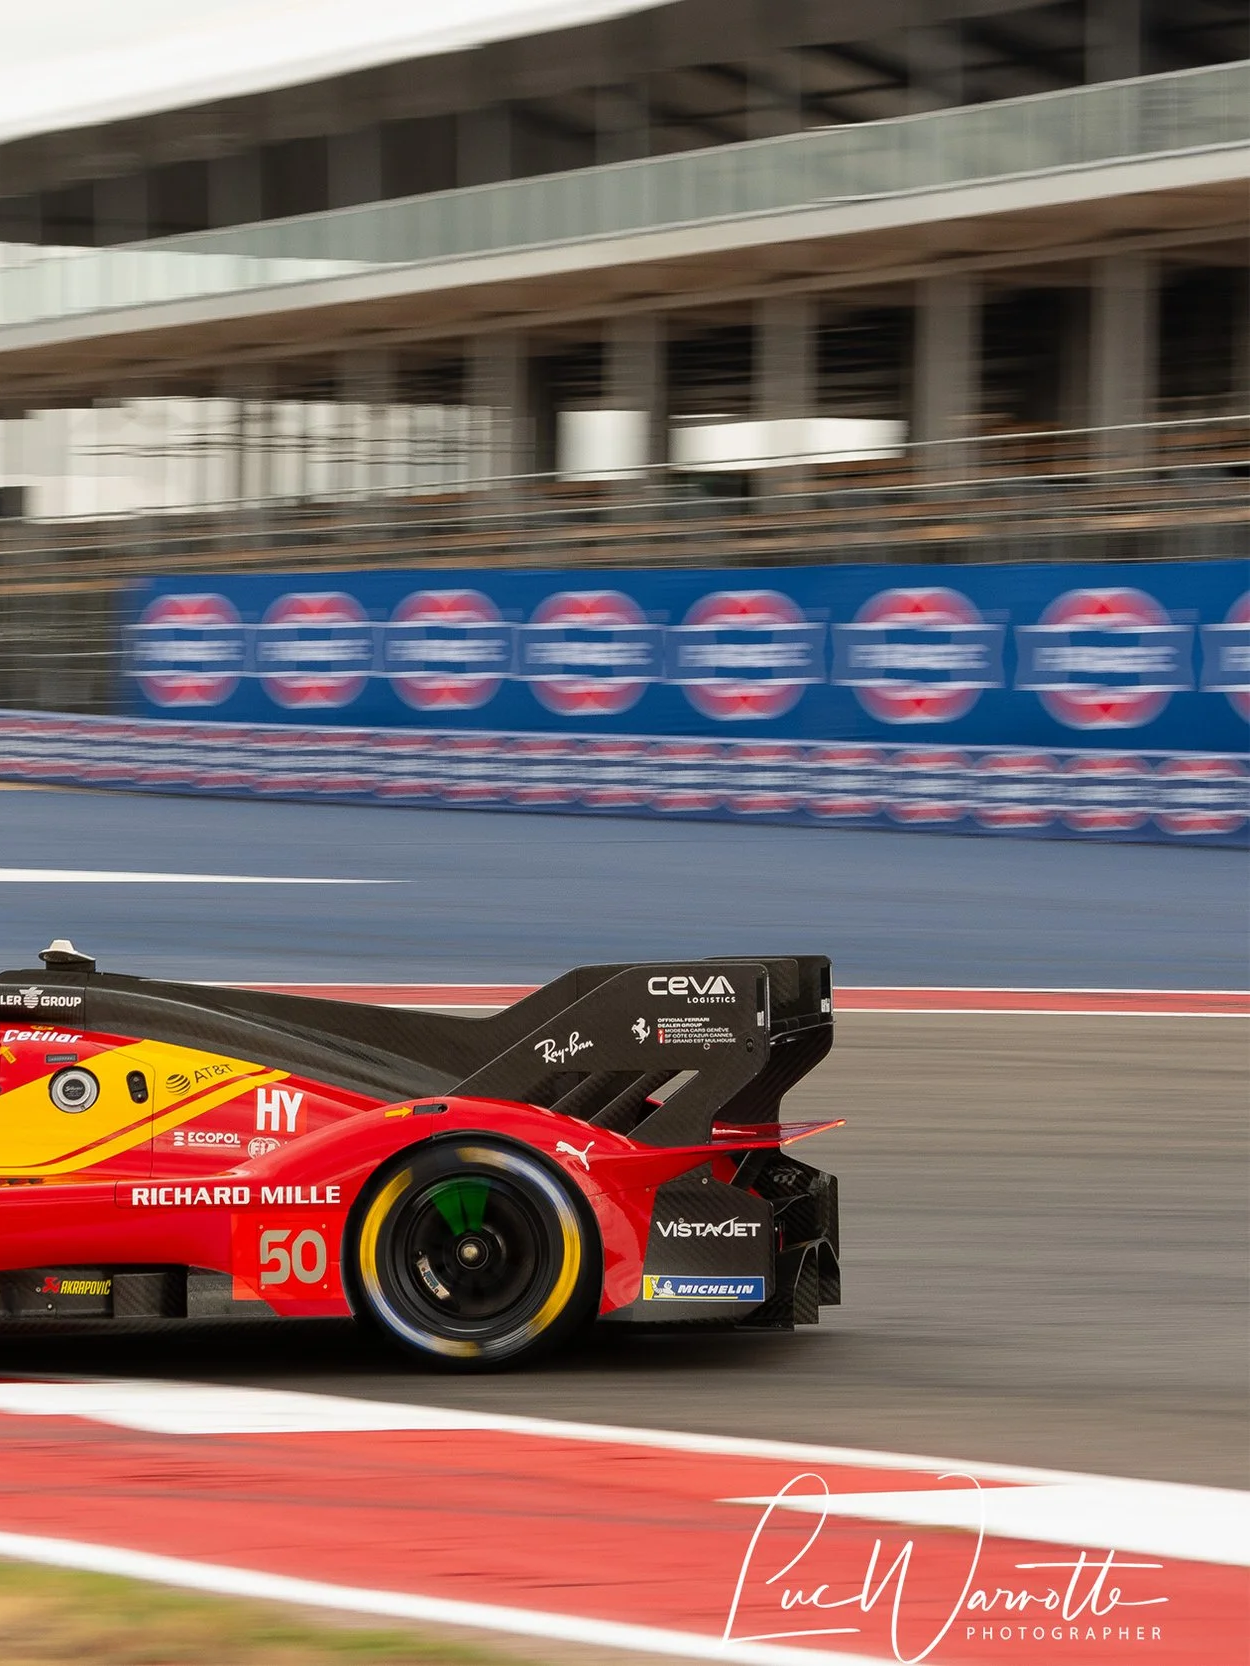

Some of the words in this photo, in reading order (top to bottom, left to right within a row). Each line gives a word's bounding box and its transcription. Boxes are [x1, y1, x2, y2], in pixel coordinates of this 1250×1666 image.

[40, 996, 82, 1007] GROUP
[687, 996, 736, 1004] LOGISTICS
[2, 1029, 83, 1044] Cetilar
[193, 1064, 234, 1083] AT&T
[256, 1088, 304, 1133] HY
[187, 1132, 241, 1144] ECOPOL
[131, 1186, 250, 1206] RICHARD
[261, 1185, 341, 1205] MILLE
[259, 1229, 327, 1285] 50
[677, 1284, 755, 1295] MICHELIN
